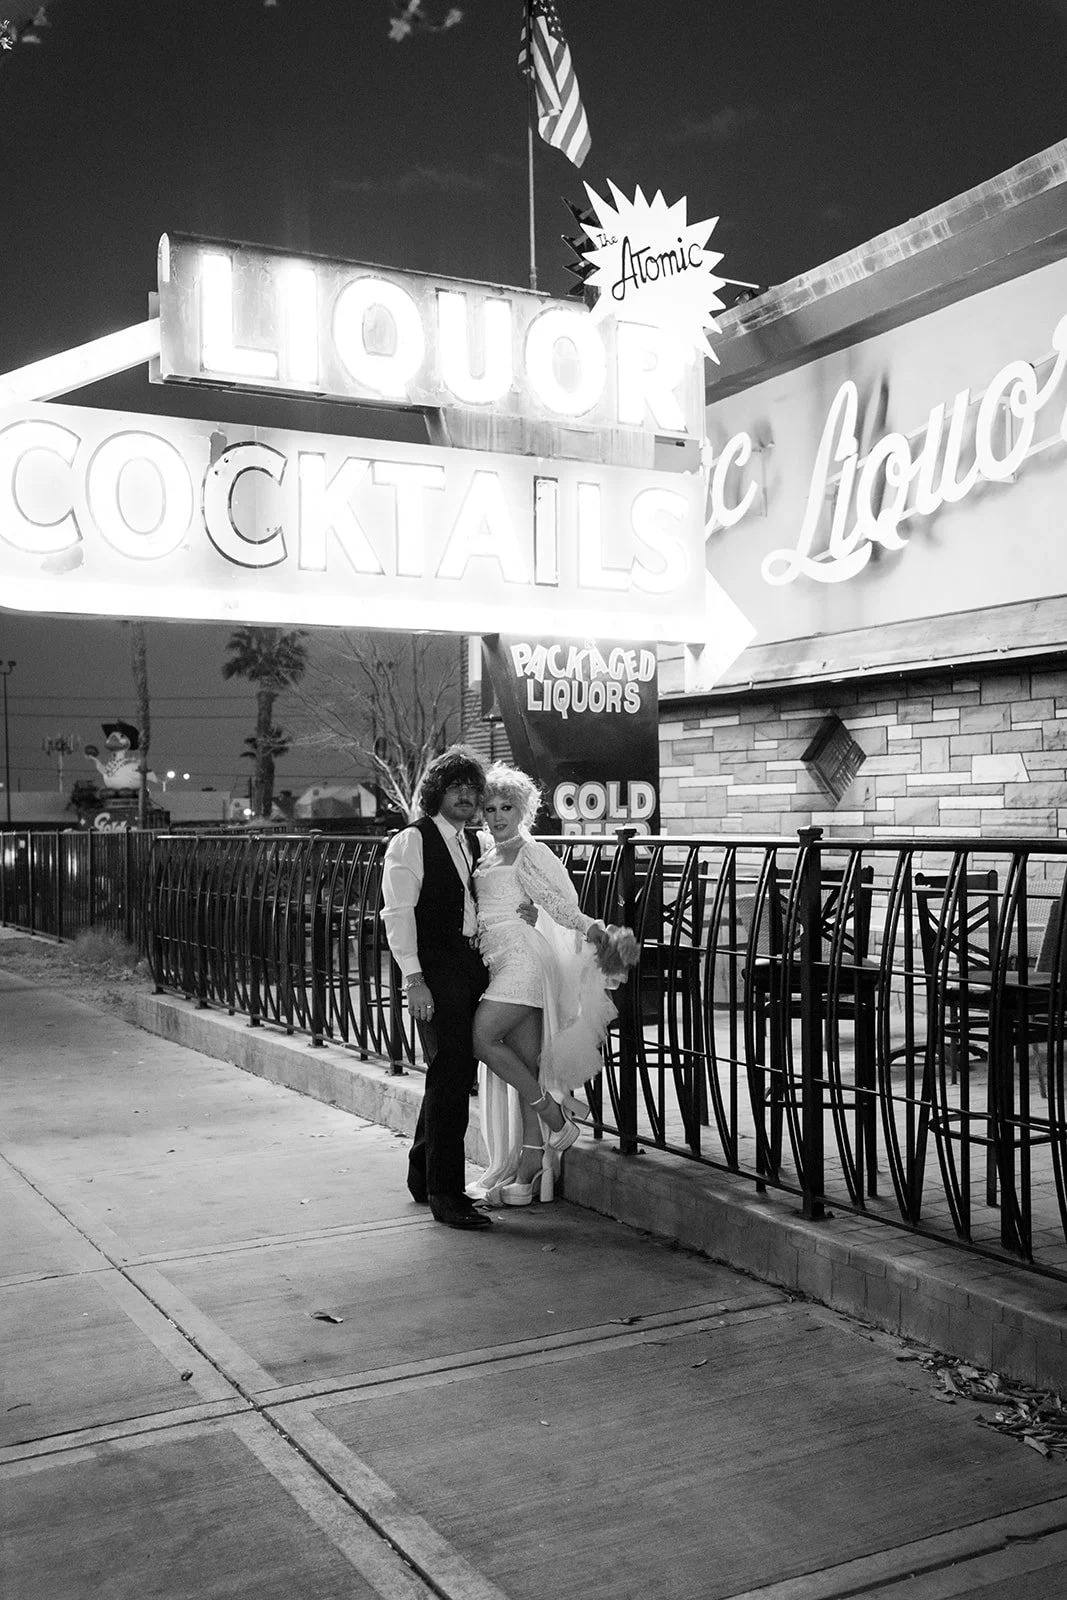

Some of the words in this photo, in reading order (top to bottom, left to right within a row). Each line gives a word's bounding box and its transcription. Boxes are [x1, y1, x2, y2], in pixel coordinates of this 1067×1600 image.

[596, 232, 619, 248] The
[199, 252, 687, 432] LIQUOR
[760, 314, 1067, 586] Liquo
[0, 418, 690, 595] COCKTAILS
[510, 643, 656, 683] PACKAGED
[526, 678, 641, 720] LIQUORS
[553, 781, 657, 821] COLD
